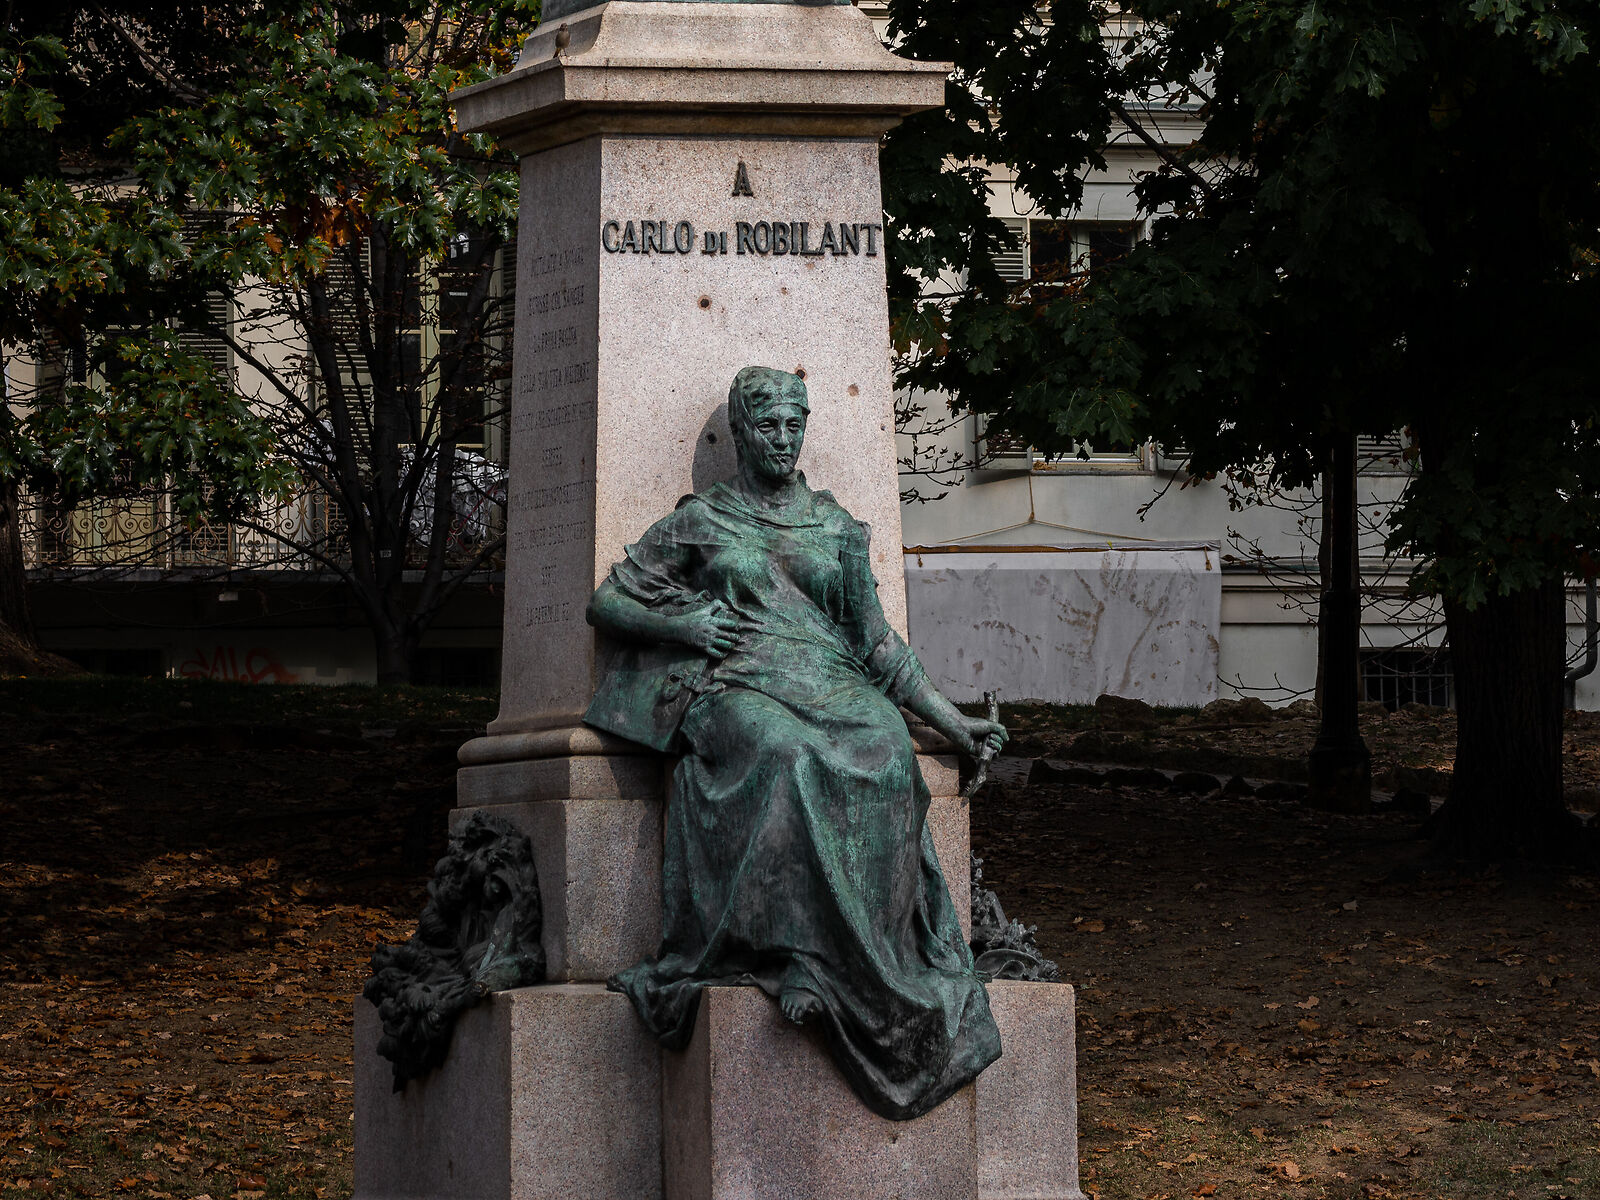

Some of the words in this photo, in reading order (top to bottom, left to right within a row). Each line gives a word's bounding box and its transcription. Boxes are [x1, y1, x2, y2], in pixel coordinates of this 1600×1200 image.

[732, 161, 753, 197] A
[602, 219, 694, 255] CARLO
[736, 221, 882, 257] ROBILANT
